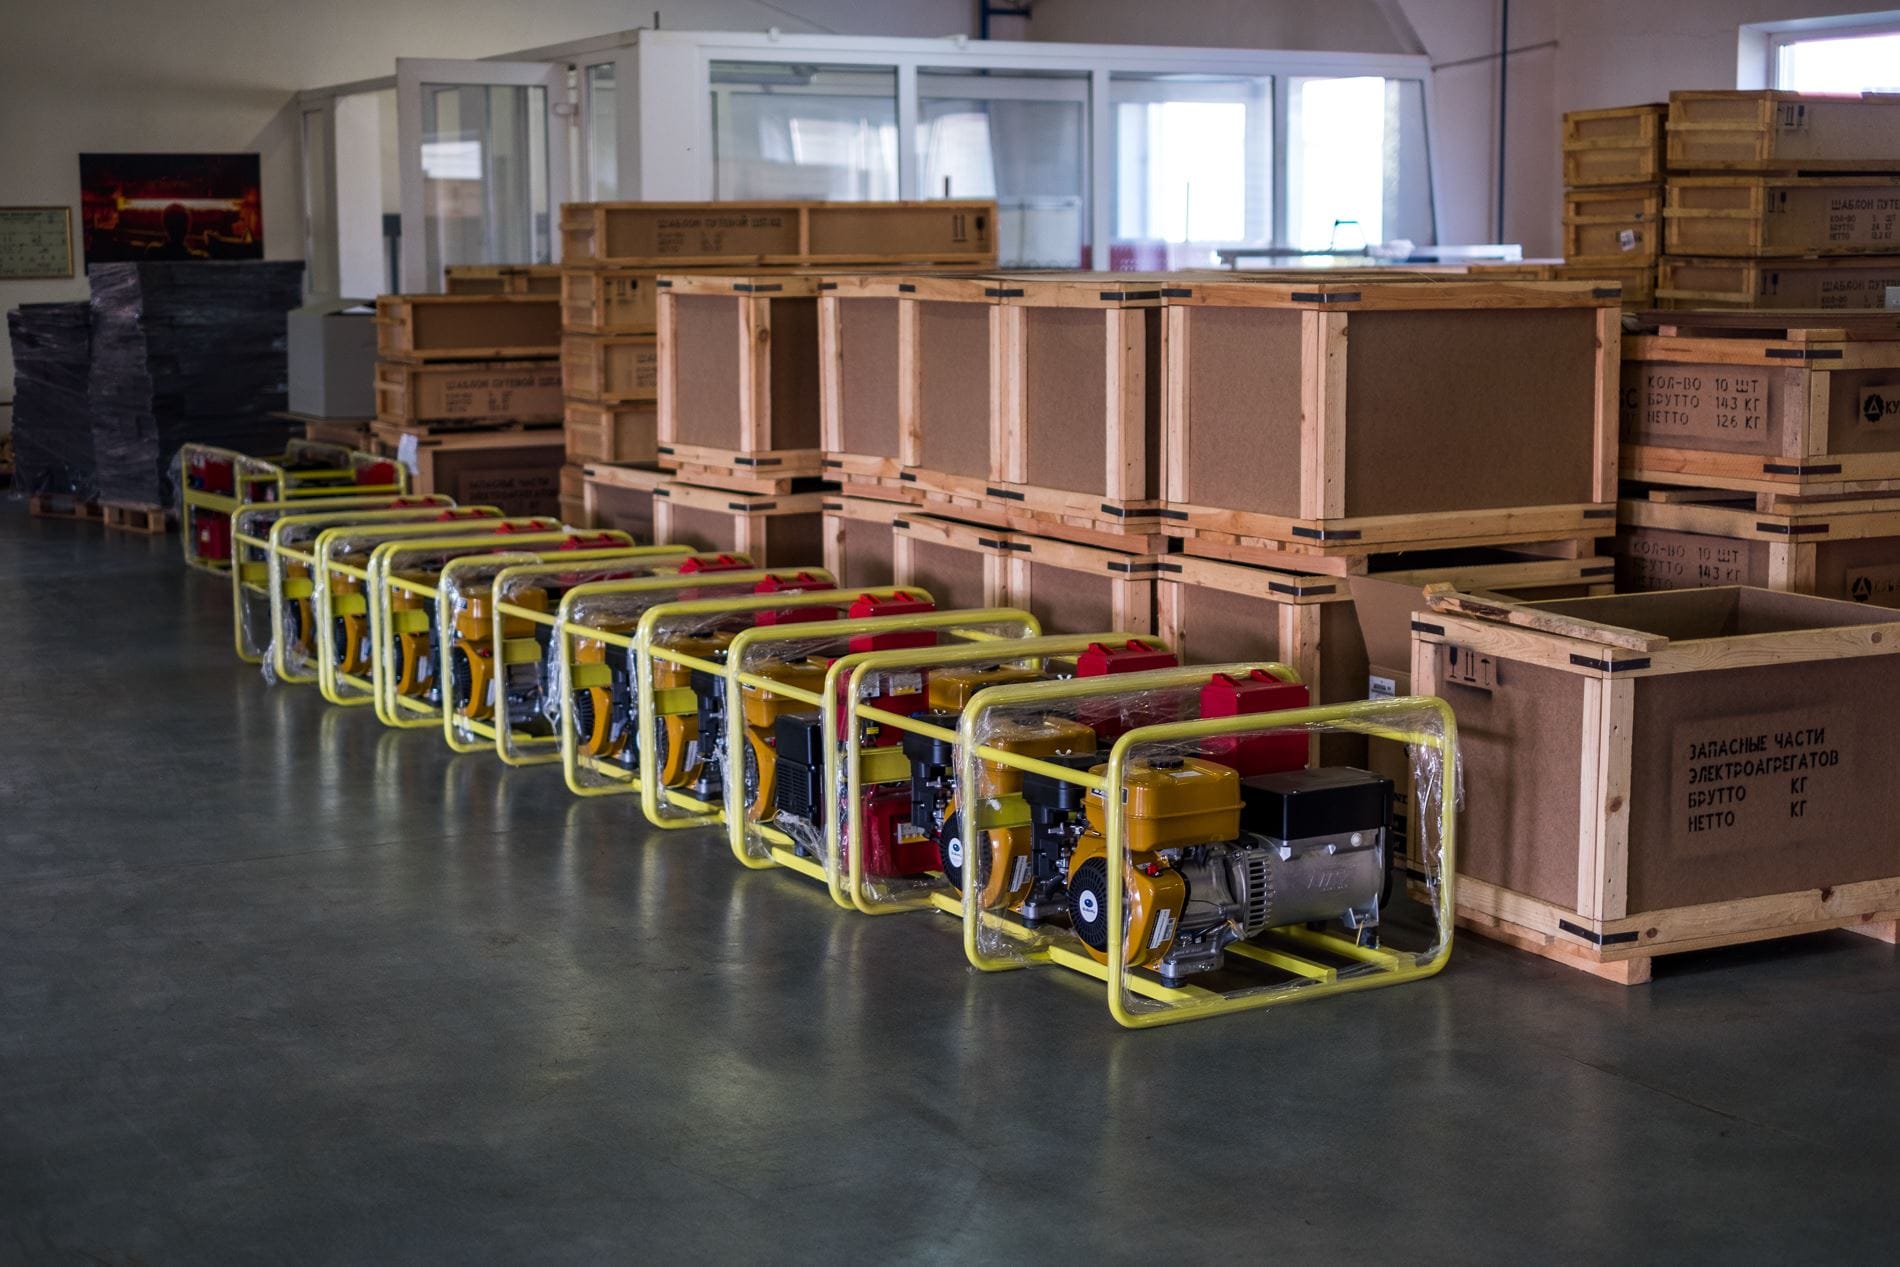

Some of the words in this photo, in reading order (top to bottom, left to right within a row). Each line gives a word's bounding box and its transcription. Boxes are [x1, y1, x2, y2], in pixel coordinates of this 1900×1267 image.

[1832, 200, 1873, 211] ШАБЛОН
[1647, 375, 1702, 392] КОЛ-ВО
[1715, 378, 1729, 392] 10
[1735, 378, 1759, 393] ШТ
[1647, 393, 1700, 409] БРУТТО
[1715, 396, 1738, 411] 143
[1744, 398, 1761, 413] КГ
[1647, 410, 1689, 426] НЕТТО
[1716, 413, 1738, 429] 126
[1745, 415, 1761, 430] КГ
[1632, 541, 1686, 558] КОЛ-ВО
[1698, 546, 1711, 561] 10
[1717, 548, 1740, 563] ШТ
[1698, 563, 1720, 580] 143
[1726, 567, 1741, 583] КГ
[1689, 735, 1767, 761] ЗАПАСНЫЕ
[1774, 728, 1825, 749] ЧАСТИ
[1689, 750, 1839, 784] ЭЛЕКТРОАГРЕГАТОВ
[1688, 785, 1746, 809] БРУТТО
[1791, 777, 1808, 794] КГ
[1688, 811, 1735, 832] НЕТТО
[1790, 800, 1807, 818] КГ
